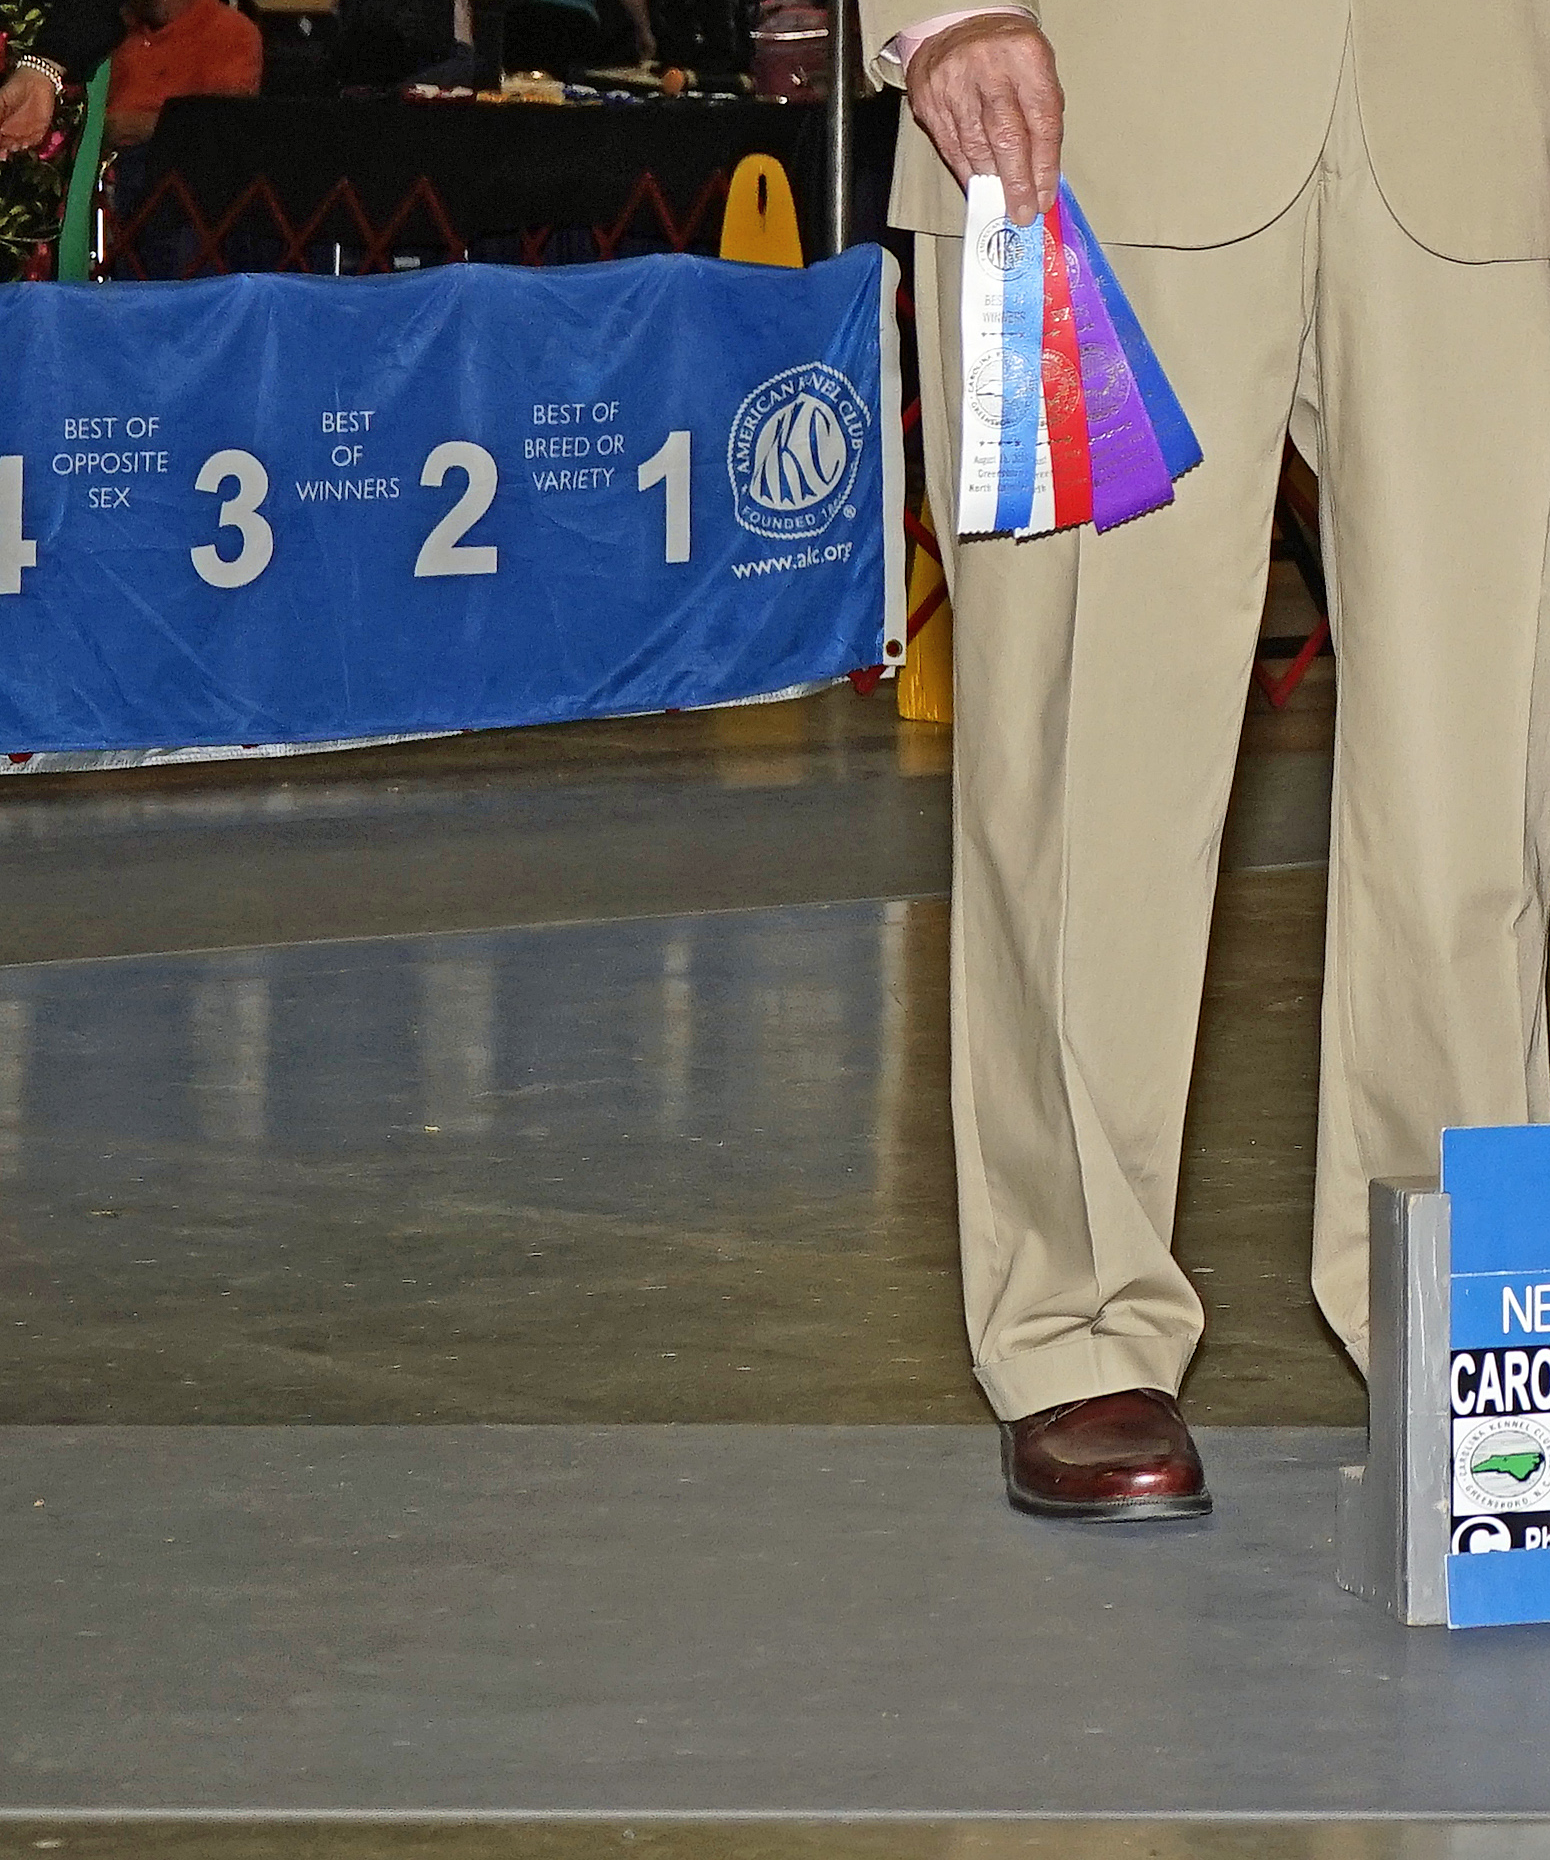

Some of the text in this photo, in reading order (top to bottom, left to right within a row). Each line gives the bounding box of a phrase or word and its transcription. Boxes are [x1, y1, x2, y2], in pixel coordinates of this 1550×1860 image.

[321, 410, 375, 433] BEST
[533, 401, 620, 425] BEST OF
[64, 416, 160, 440] BEST OF
[737, 380, 795, 474] AMERICAN
[839, 401, 864, 450] CLUB
[331, 444, 364, 467] OF
[524, 434, 625, 460] BREED OR
[52, 450, 169, 475] OPPOSITE
[296, 478, 400, 501] WINNERS
[532, 468, 615, 492] VARIETY
[88, 487, 131, 509] SEX
[414, 440, 498, 577] 2
[637, 430, 691, 563] 1
[190, 448, 274, 589] 3
[741, 505, 816, 529] FOUNDED
[731, 541, 853, 579] www.akc.org
[1489, 1420, 1530, 1431] KENNEL
